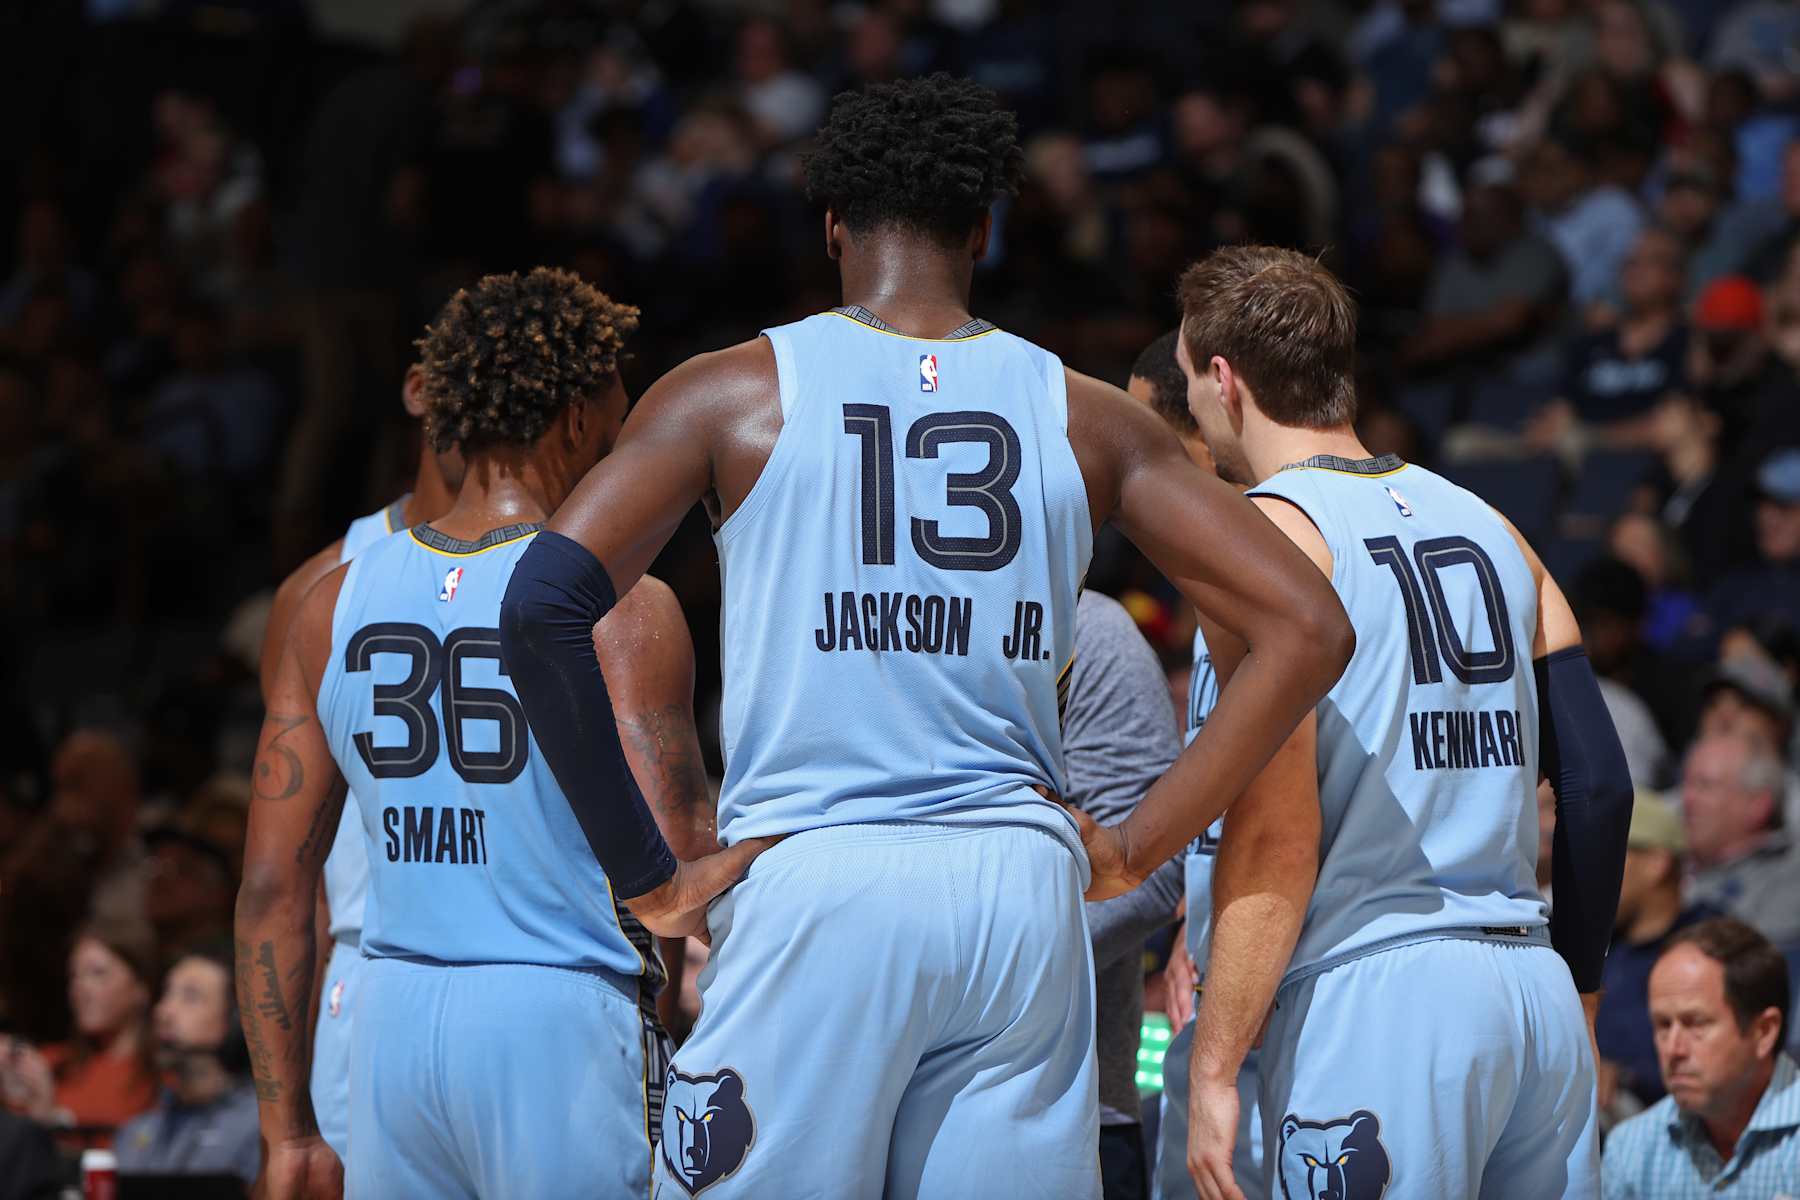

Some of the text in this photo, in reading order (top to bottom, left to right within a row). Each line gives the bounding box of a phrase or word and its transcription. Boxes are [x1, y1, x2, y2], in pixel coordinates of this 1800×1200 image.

[843, 404, 1022, 571] 13
[815, 592, 1051, 660] JACKSON JR.
[1364, 536, 1515, 685] 10
[345, 622, 528, 784] 36
[383, 806, 487, 864] SMART
